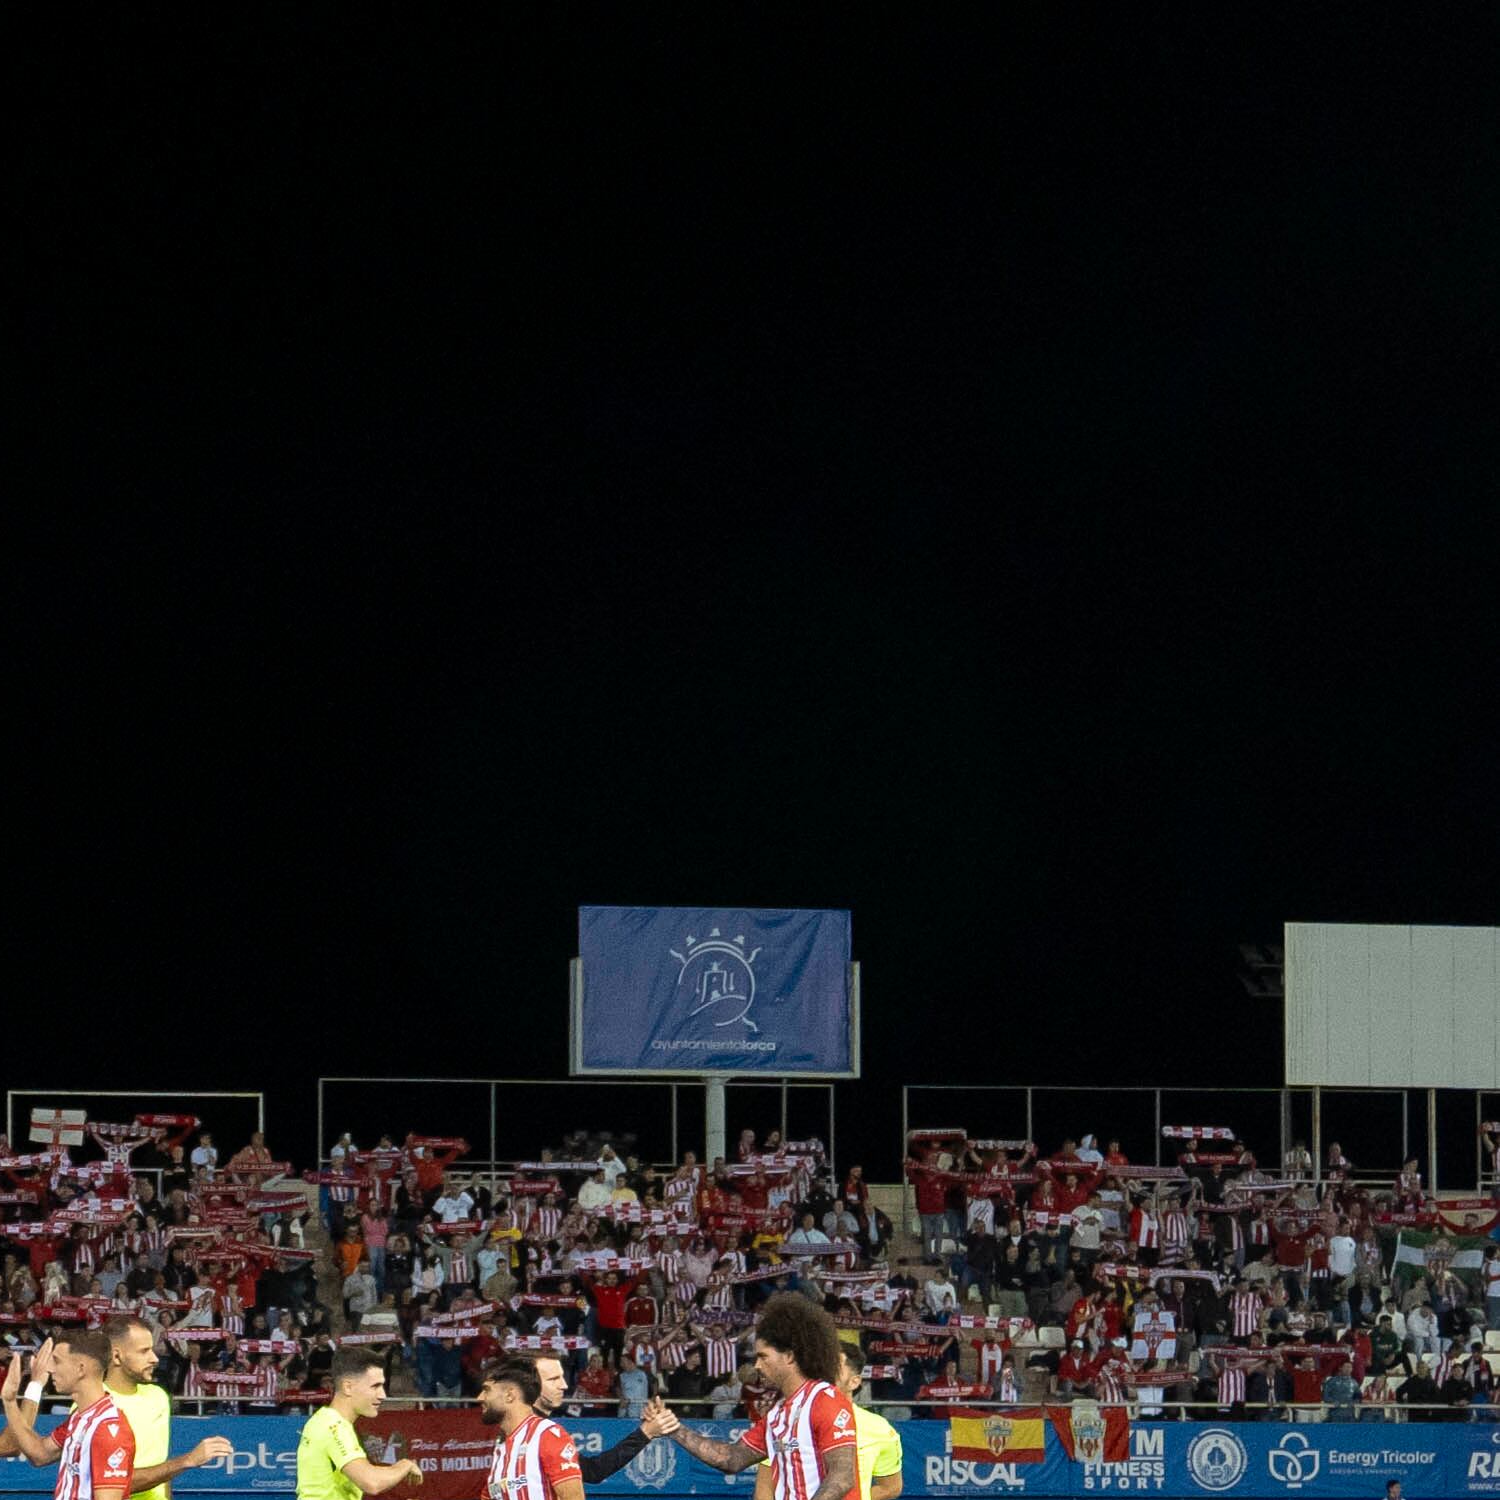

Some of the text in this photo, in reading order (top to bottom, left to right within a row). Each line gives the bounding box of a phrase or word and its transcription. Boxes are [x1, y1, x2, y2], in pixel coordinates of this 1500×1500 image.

[1328, 1450, 1437, 1466] Energy Tricolor
[925, 1455, 1026, 1487] RISCAL
[1084, 1461, 1165, 1477] FITNESS
